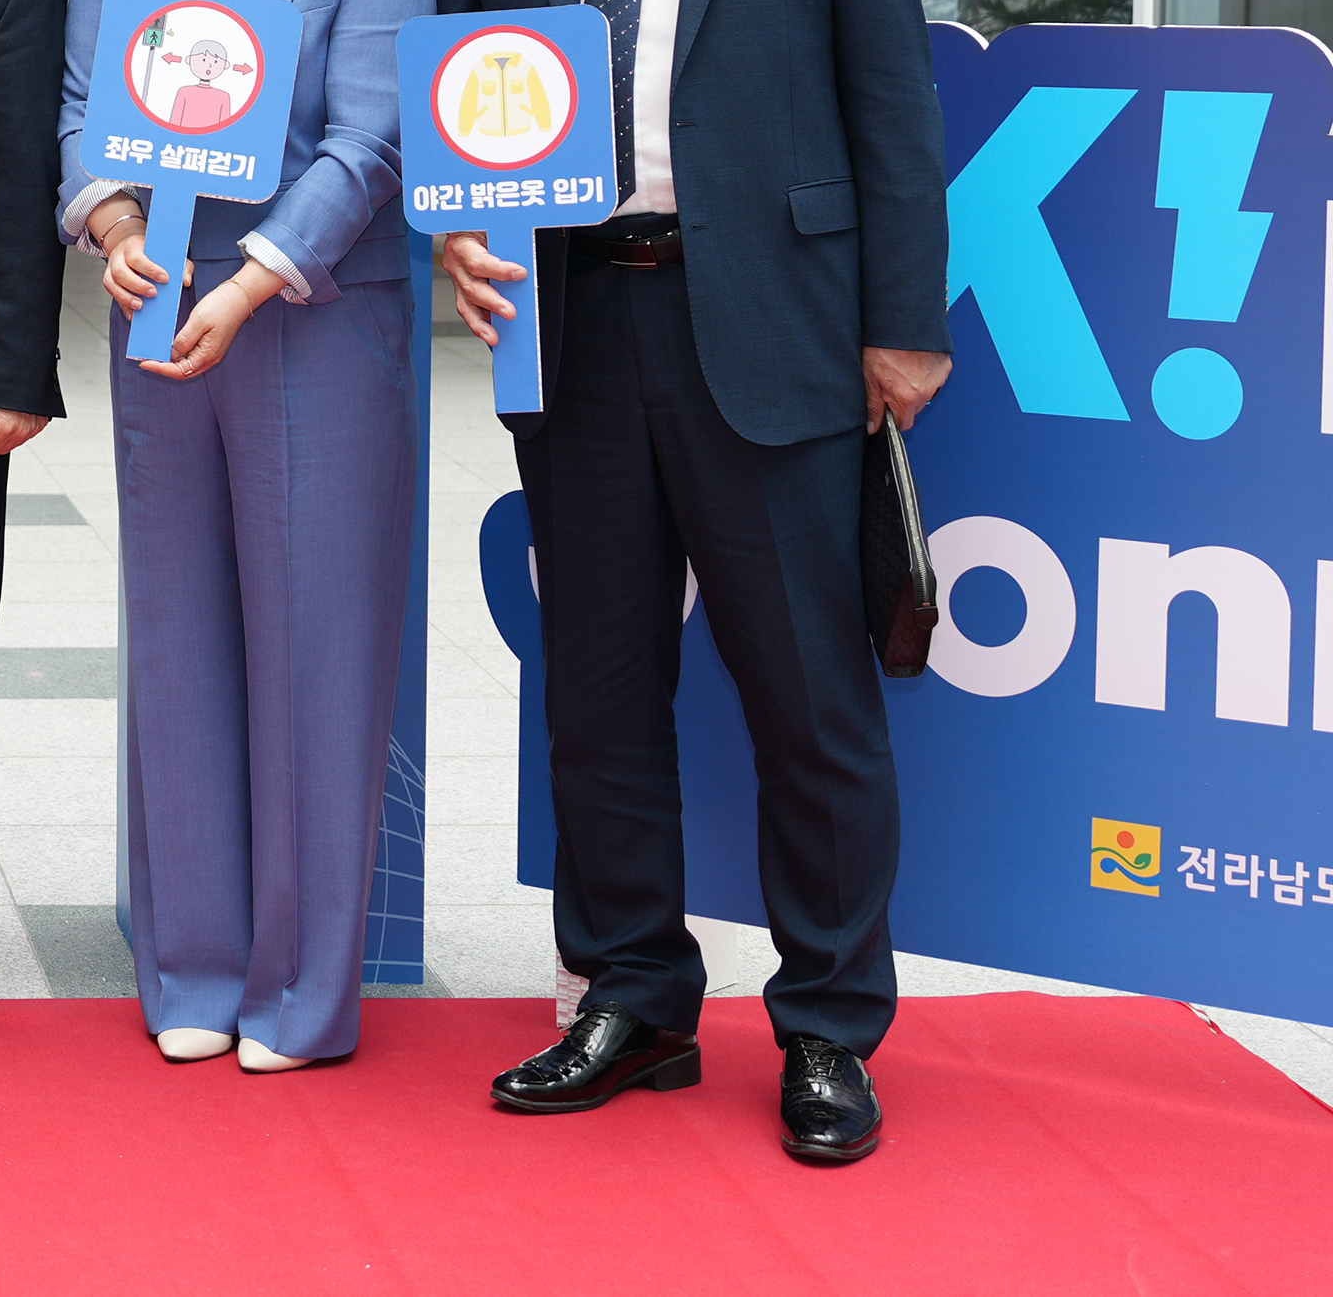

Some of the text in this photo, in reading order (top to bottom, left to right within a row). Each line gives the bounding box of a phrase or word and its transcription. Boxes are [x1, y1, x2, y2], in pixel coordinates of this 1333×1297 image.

[104, 135, 256, 181] 좌우 살펴걷기
[413, 176, 604, 211] 야간 밝은옷 입기
[945, 86, 1274, 441] K!
